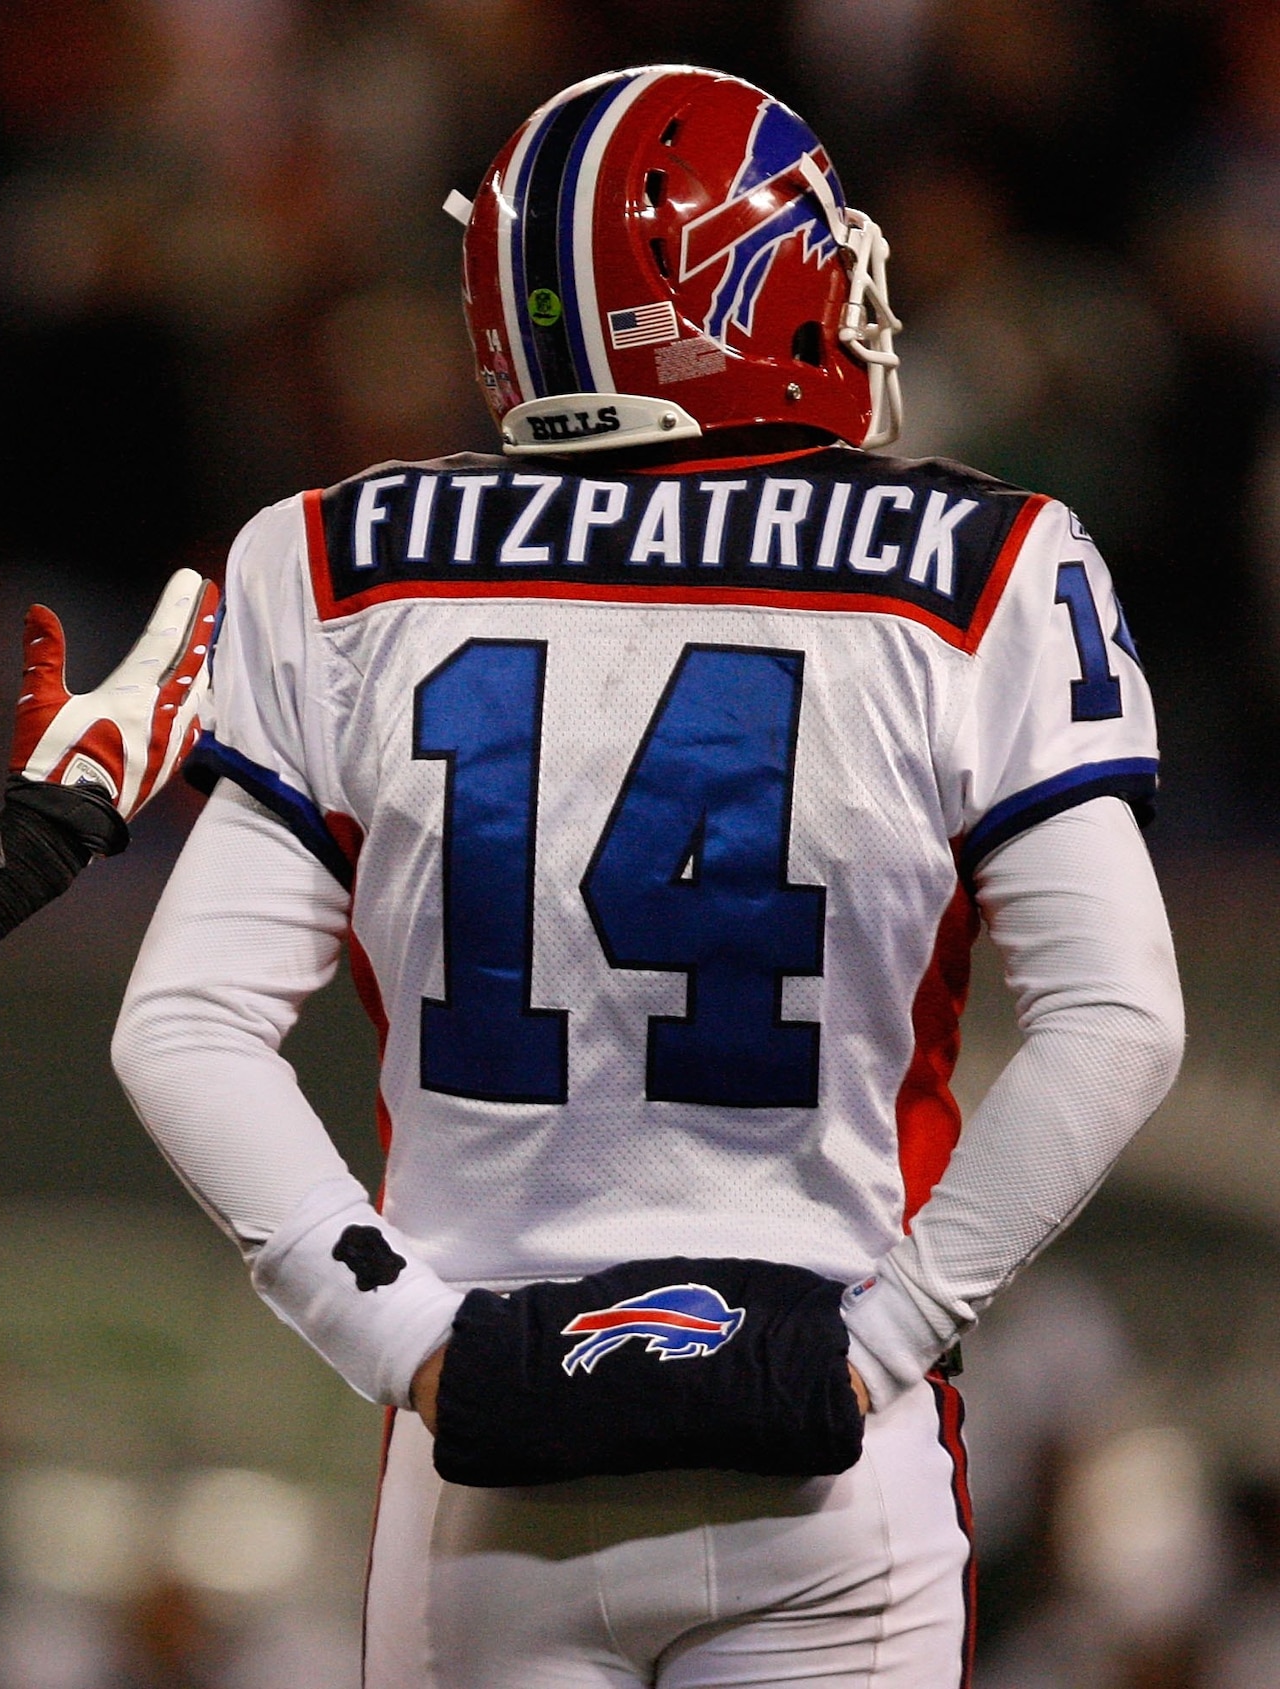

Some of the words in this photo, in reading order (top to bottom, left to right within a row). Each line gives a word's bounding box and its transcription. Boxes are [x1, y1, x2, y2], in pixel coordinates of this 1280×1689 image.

[526, 405, 621, 441] BILLS
[352, 473, 979, 596] FITZPATRICK
[412, 636, 827, 1109] 14
